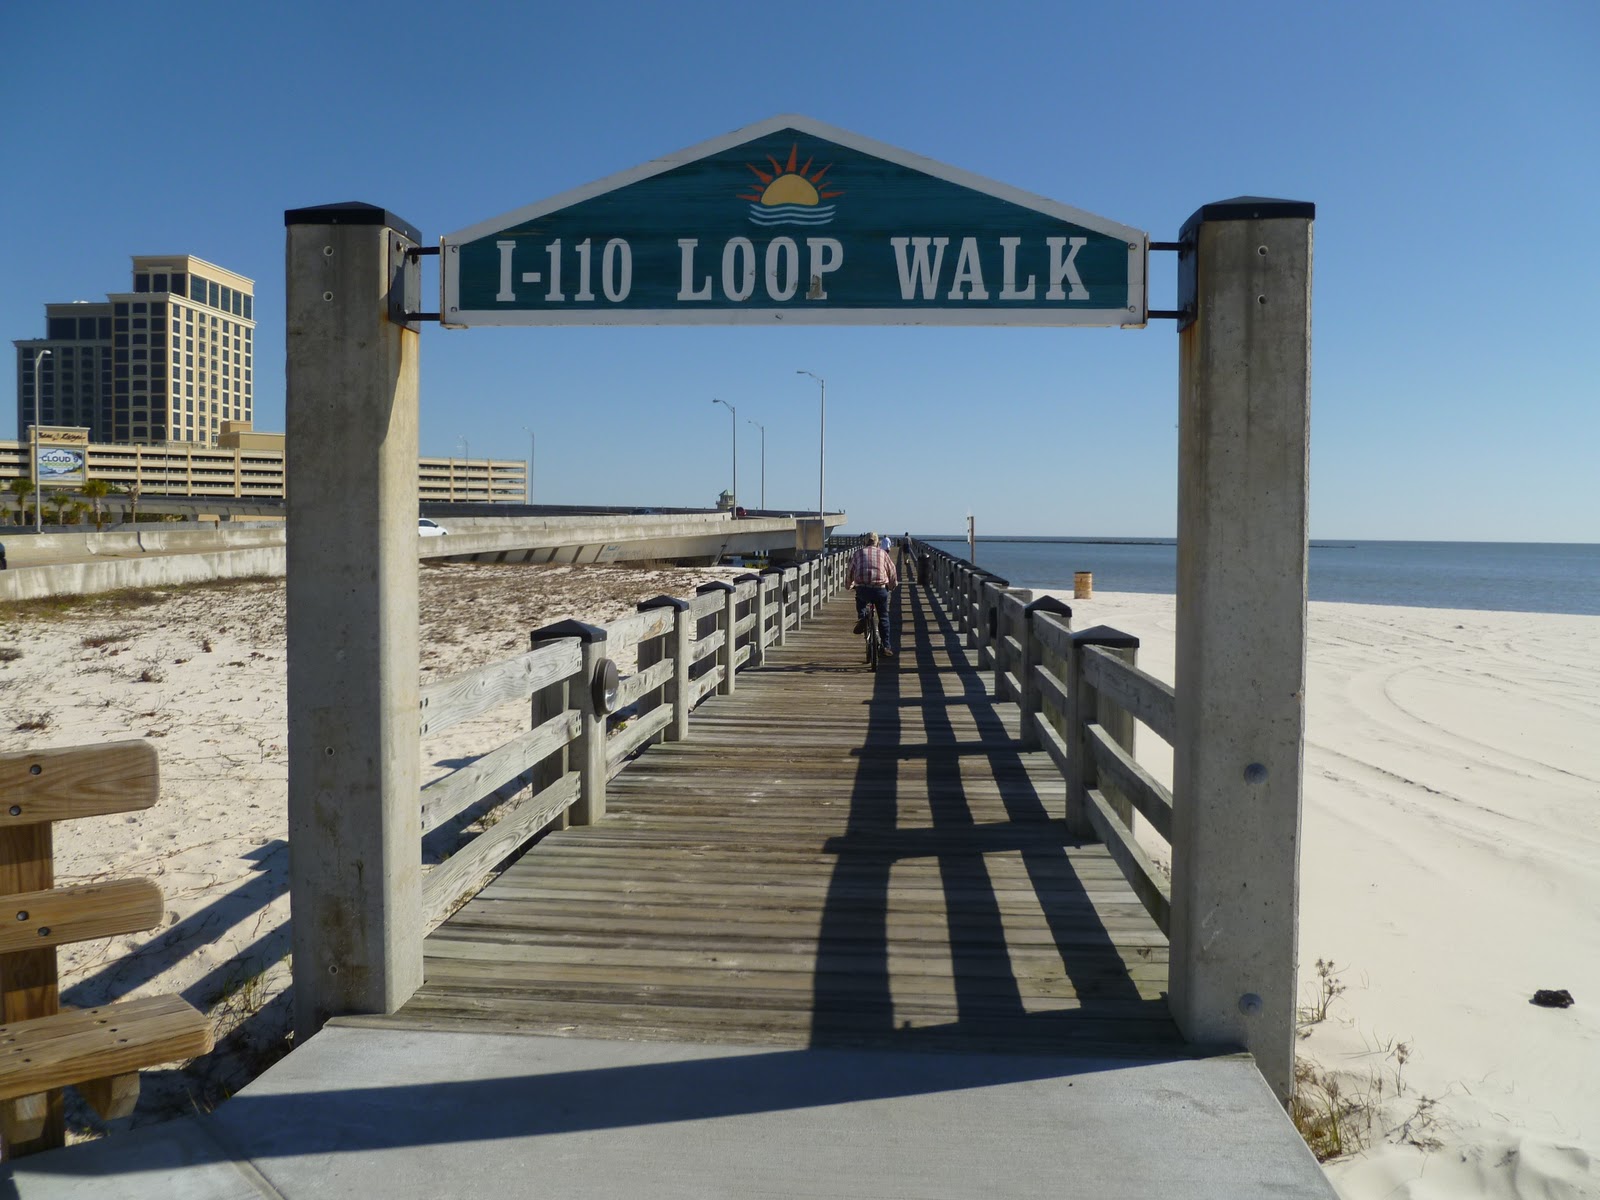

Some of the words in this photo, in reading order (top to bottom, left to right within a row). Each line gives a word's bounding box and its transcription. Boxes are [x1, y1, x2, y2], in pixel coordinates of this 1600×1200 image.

[496, 237, 632, 302] I-110
[677, 236, 844, 302] LOOP
[890, 236, 1090, 301] WALK
